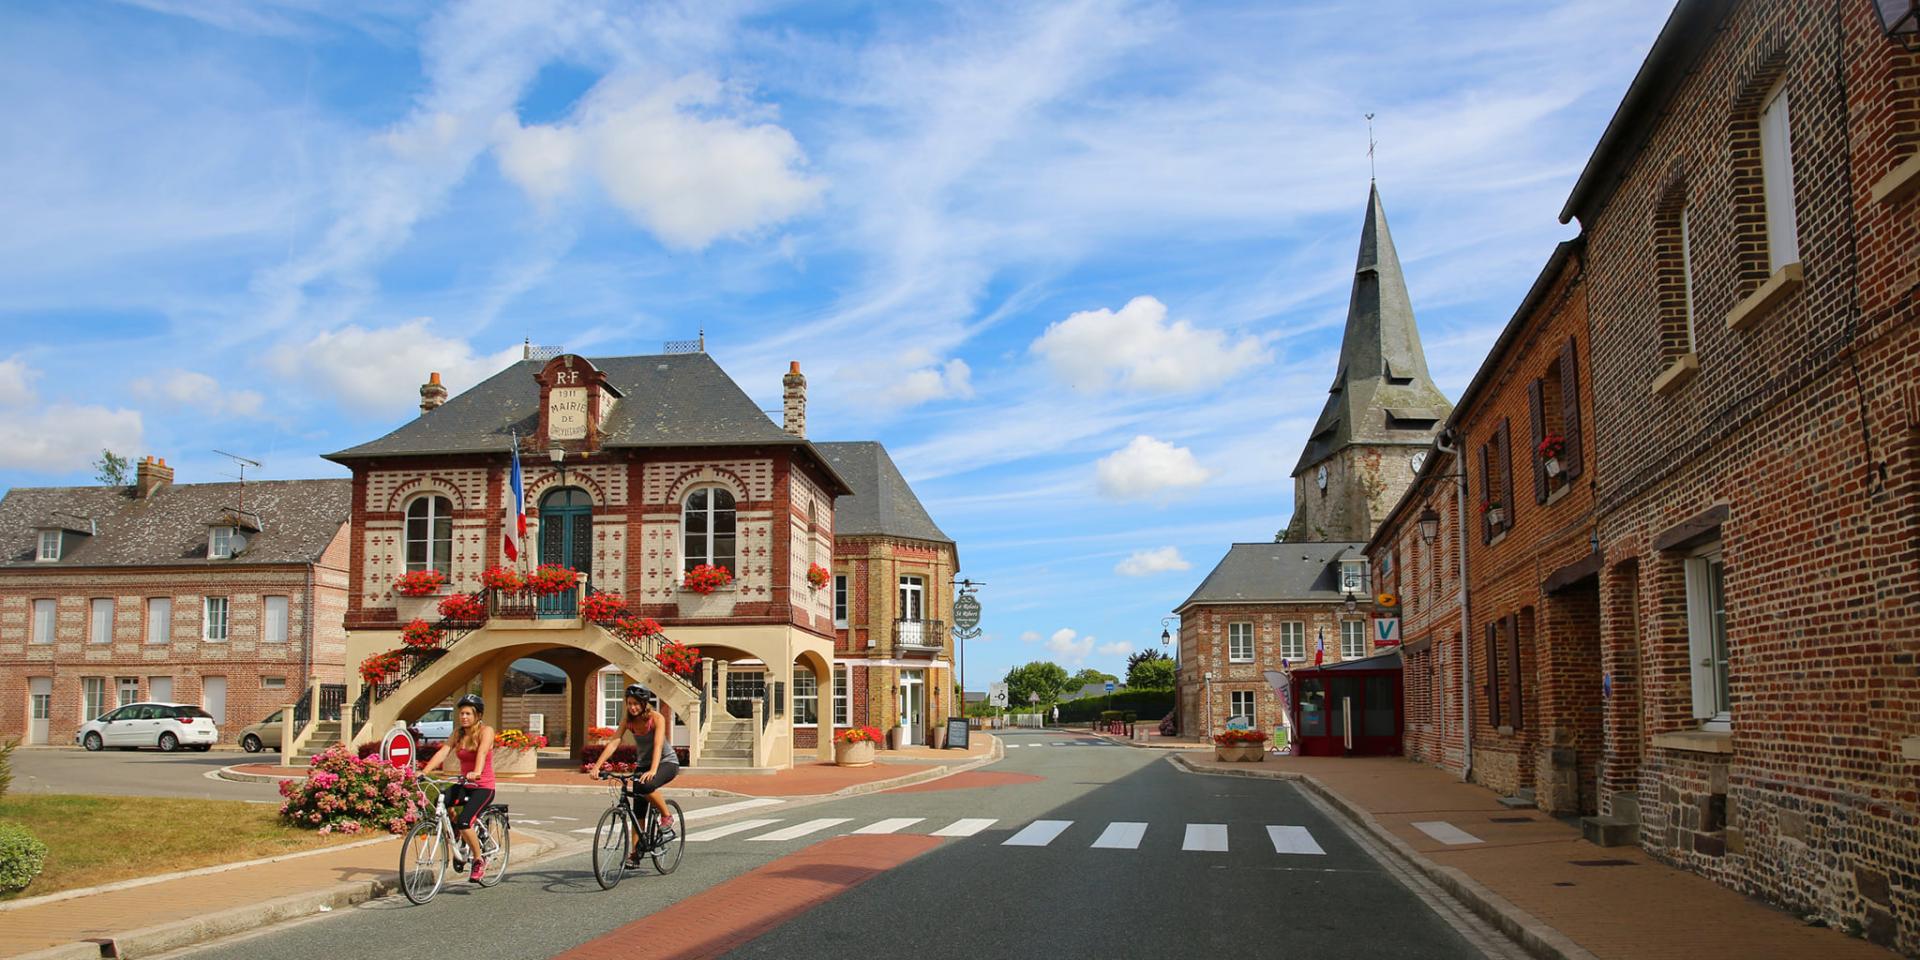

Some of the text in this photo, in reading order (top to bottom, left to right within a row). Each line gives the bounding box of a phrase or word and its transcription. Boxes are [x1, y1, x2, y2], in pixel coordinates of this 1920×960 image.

[559, 390, 576, 398] 1911
[551, 402, 586, 414] MAIRIE
[1378, 620, 1395, 639] V
